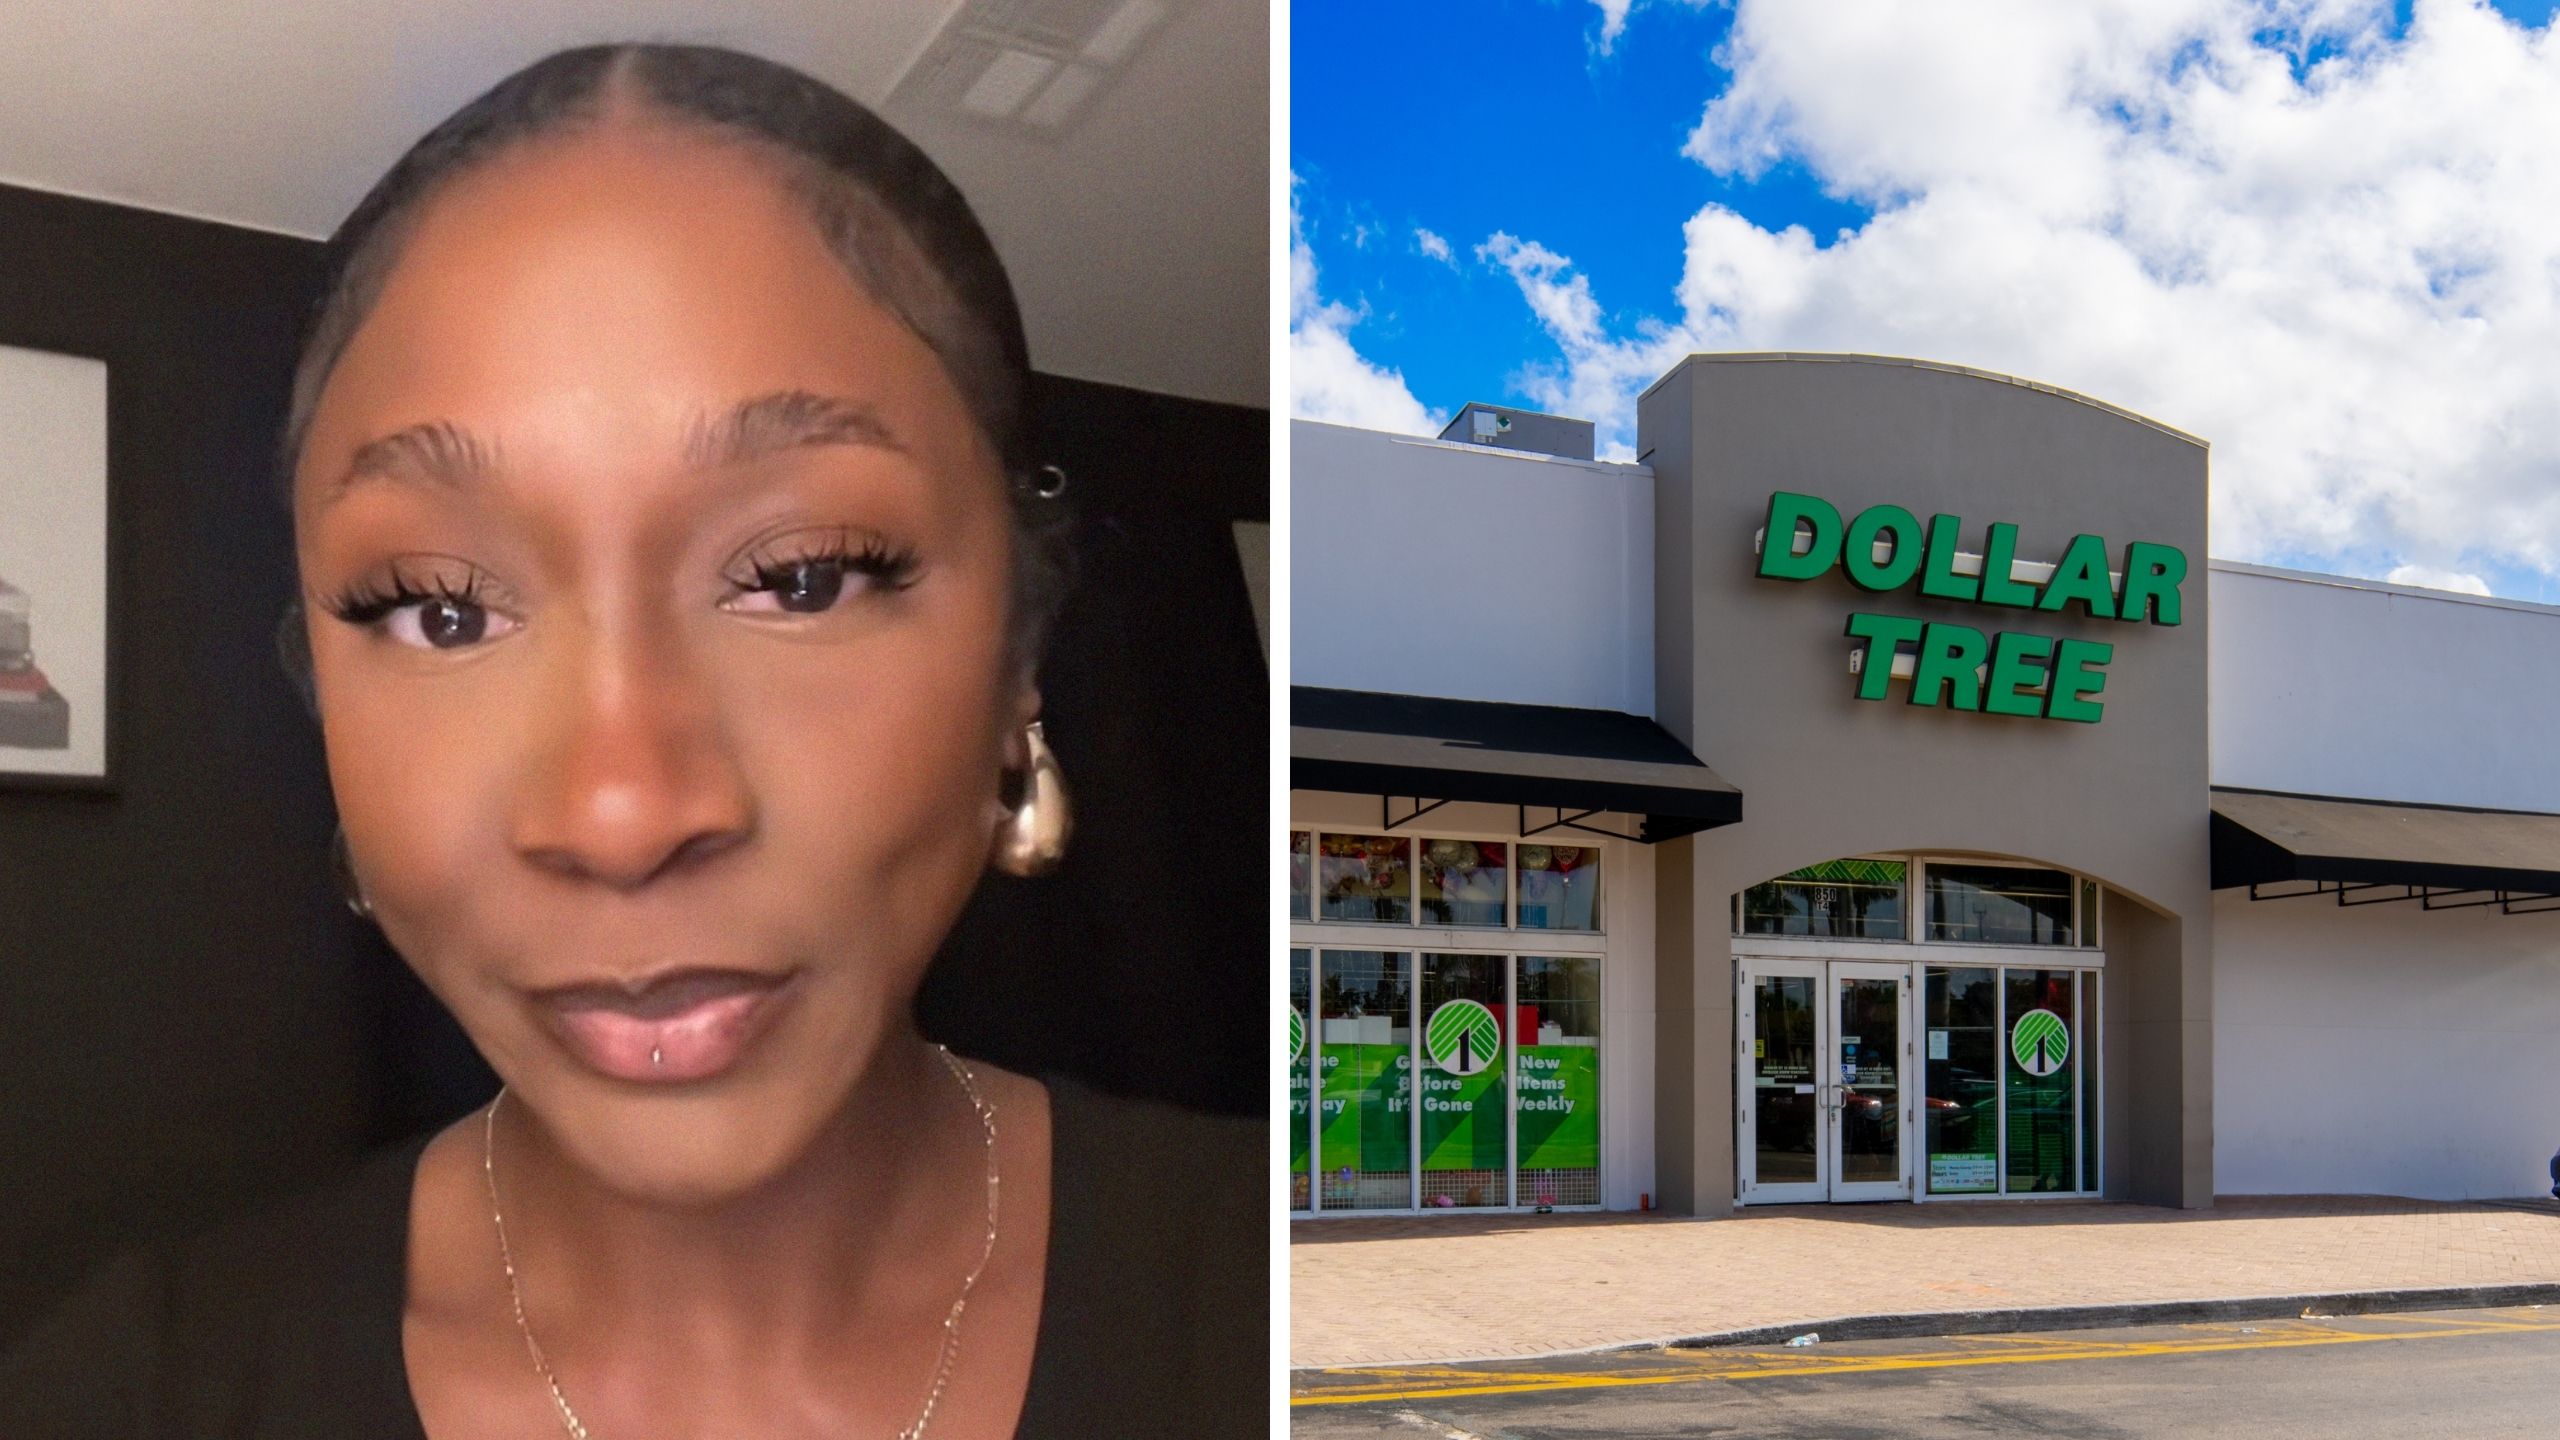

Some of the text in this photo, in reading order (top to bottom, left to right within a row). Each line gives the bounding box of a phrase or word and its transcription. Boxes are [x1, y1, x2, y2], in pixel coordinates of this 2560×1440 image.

[1755, 490, 2188, 626] DOLLAR
[1844, 612, 2114, 724] TREE
[1815, 887, 1836, 901] 850
[1519, 1055, 1560, 1069] New
[1399, 1075, 1463, 1091] Bfore
[1516, 1075, 1566, 1090] Items
[1424, 1096, 1473, 1112] Gone
